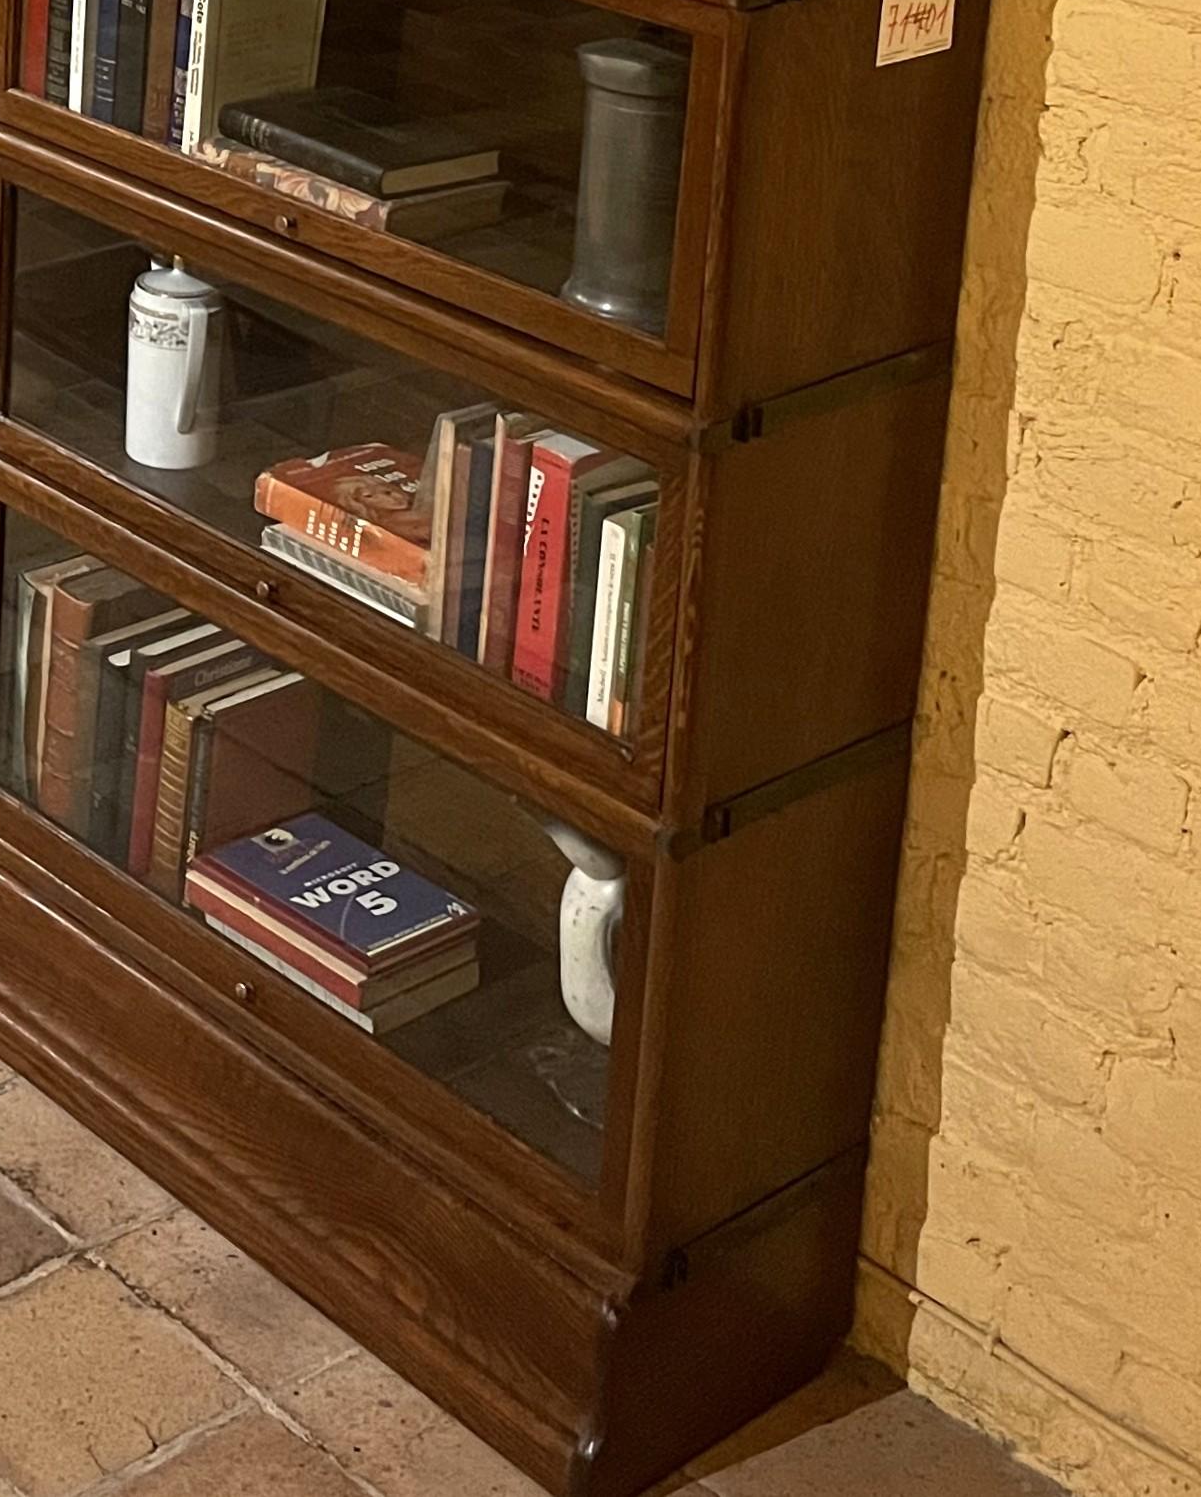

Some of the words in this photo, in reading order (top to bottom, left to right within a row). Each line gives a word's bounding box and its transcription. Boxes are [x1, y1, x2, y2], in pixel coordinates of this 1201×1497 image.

[306, 509, 316, 535] tous
[289, 860, 401, 909] WORD
[304, 862, 358, 887] MICROSOFT
[355, 890, 398, 917] 5
